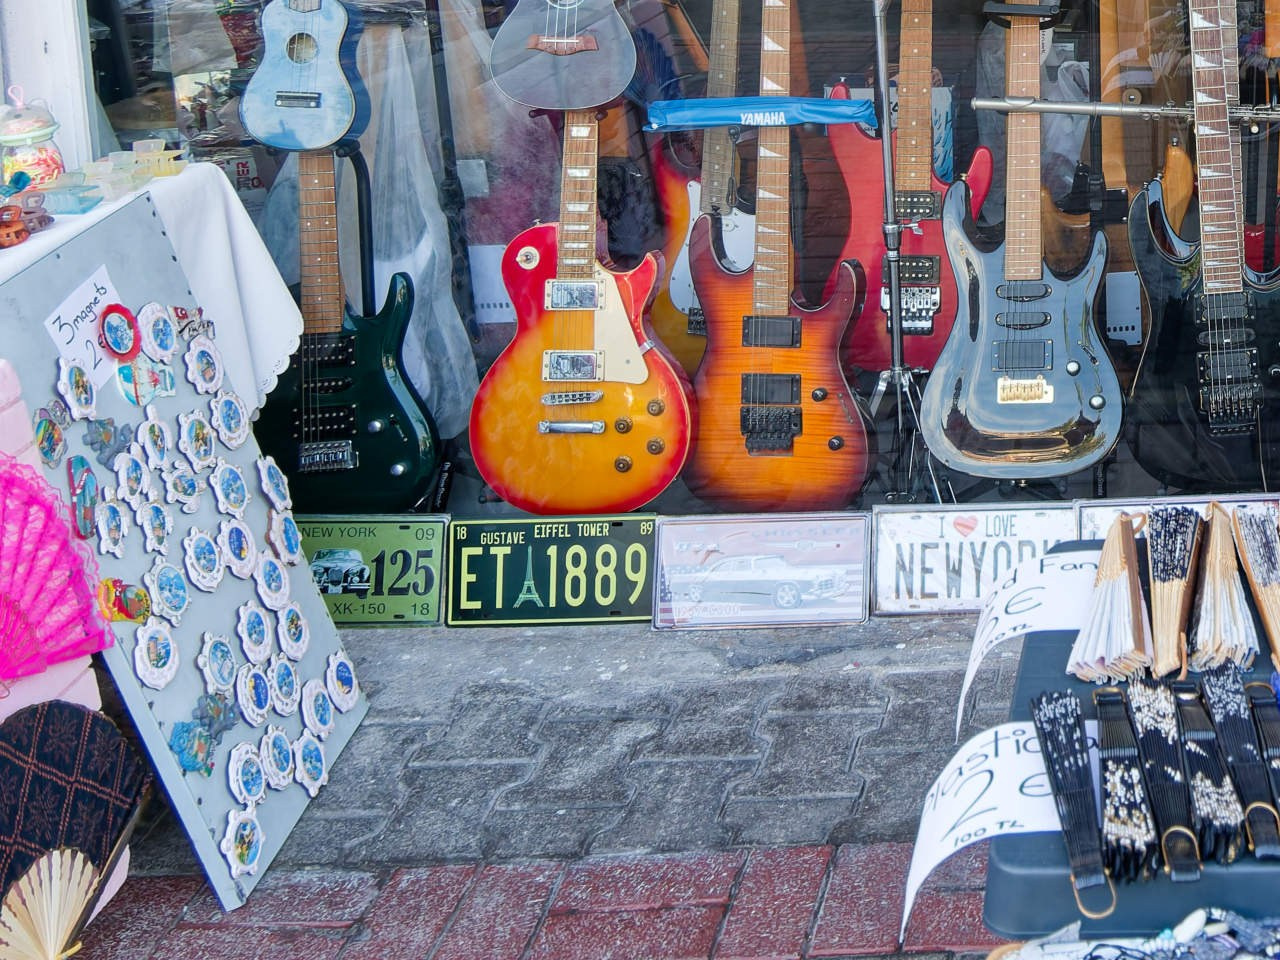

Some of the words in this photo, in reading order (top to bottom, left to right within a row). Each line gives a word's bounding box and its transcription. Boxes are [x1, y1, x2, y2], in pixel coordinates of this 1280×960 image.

[740, 111, 787, 126] YAMAHA
[51, 315, 75, 345] 3
[72, 282, 107, 331] magnets
[85, 339, 103, 371] 2
[301, 527, 334, 538] NEW
[339, 526, 378, 538] YORK
[415, 527, 435, 540] 09
[456, 526, 467, 540] 18
[480, 531, 526, 545] GUSTAVE
[534, 523, 571, 538] EIFFEL
[577, 522, 610, 538] TOWER
[640, 521, 654, 535] 89
[938, 516, 946, 539] I
[985, 514, 1018, 537] LOVE
[370, 549, 435, 597] 125
[459, 546, 512, 610] ET
[546, 542, 648, 608] 1889
[894, 539, 1062, 600] NEWYO
[333, 602, 386, 615] XK-150
[411, 602, 430, 616] 18
[940, 769, 998, 842] 2
[954, 827, 987, 848] 100
[996, 819, 1025, 830] TL
